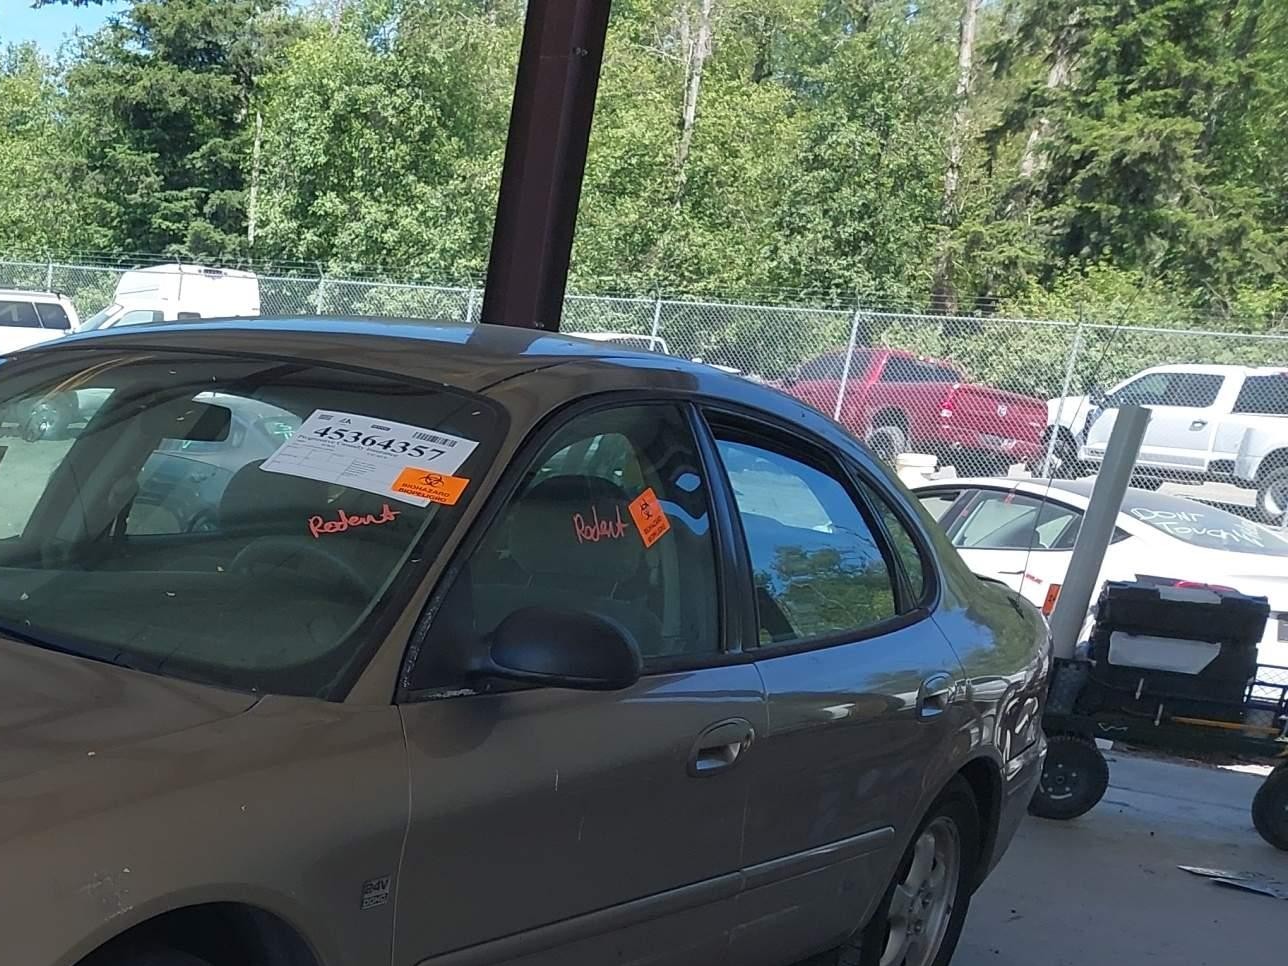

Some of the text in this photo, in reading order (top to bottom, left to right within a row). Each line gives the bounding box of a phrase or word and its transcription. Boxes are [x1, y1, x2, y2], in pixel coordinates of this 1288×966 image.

[314, 426, 446, 462] 45364357
[398, 487, 447, 502] BIOPELIGRO
[402, 482, 450, 498] BIOHAZARD
[308, 503, 400, 538] Rodent
[573, 505, 628, 543] Rodent
